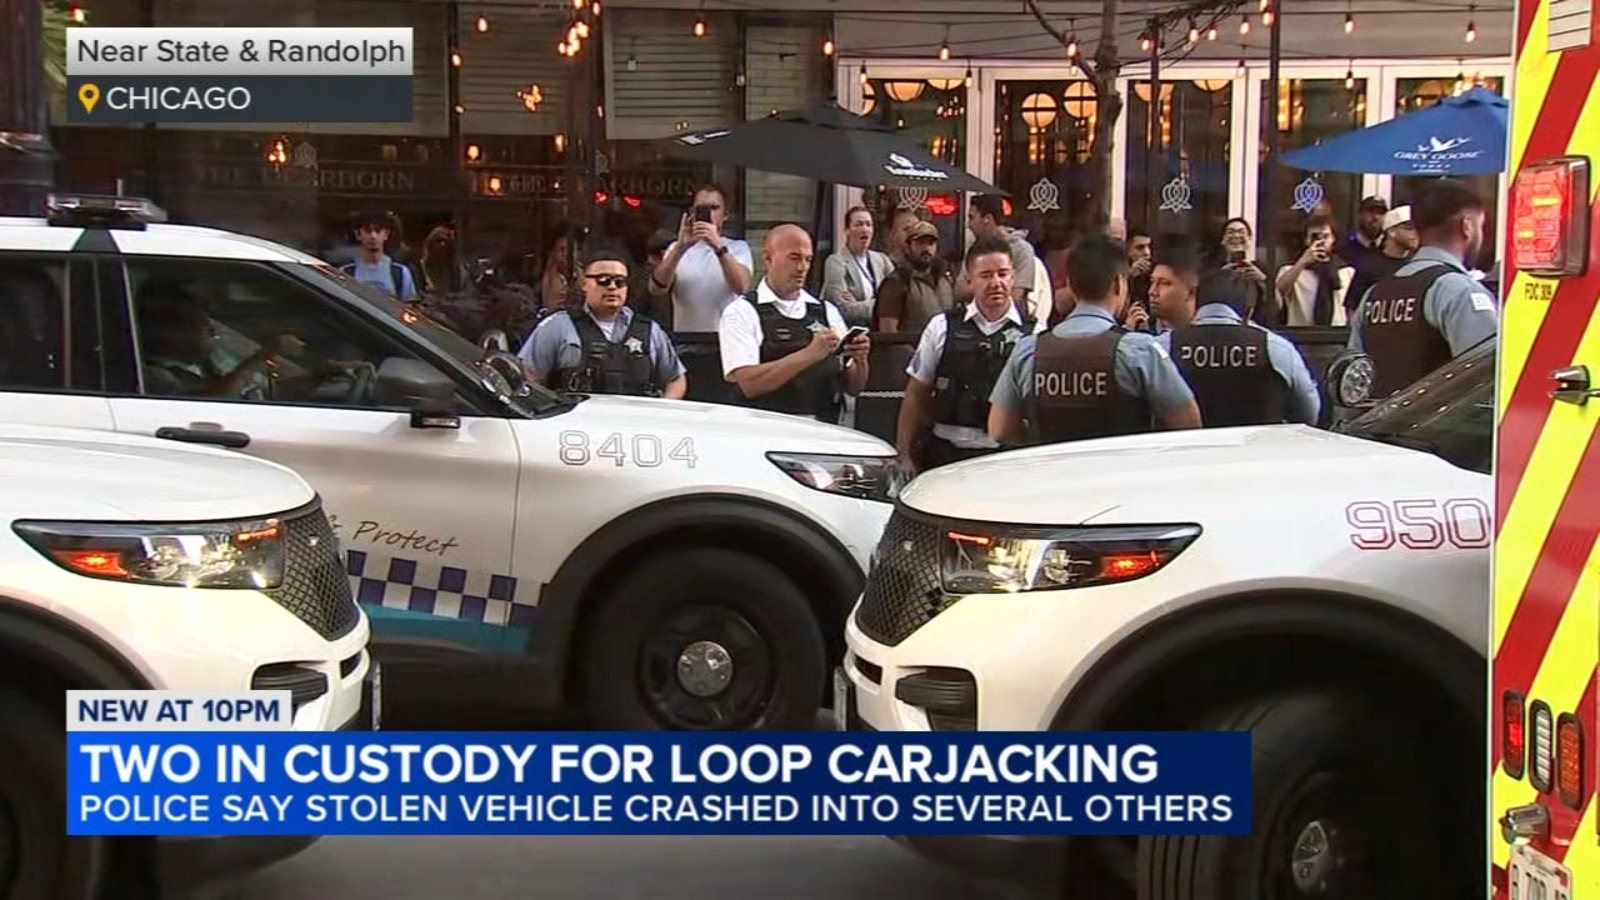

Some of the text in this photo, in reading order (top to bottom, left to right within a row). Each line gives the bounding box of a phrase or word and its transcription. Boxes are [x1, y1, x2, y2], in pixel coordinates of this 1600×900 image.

[1394, 152, 1427, 160] GREY
[262, 168, 415, 190] DRBORN
[1181, 345, 1258, 367] POLICE
[1034, 372, 1107, 396] POLICE
[559, 429, 699, 468] 8404
[1345, 498, 1491, 550] 950
[352, 520, 459, 556] Protect
